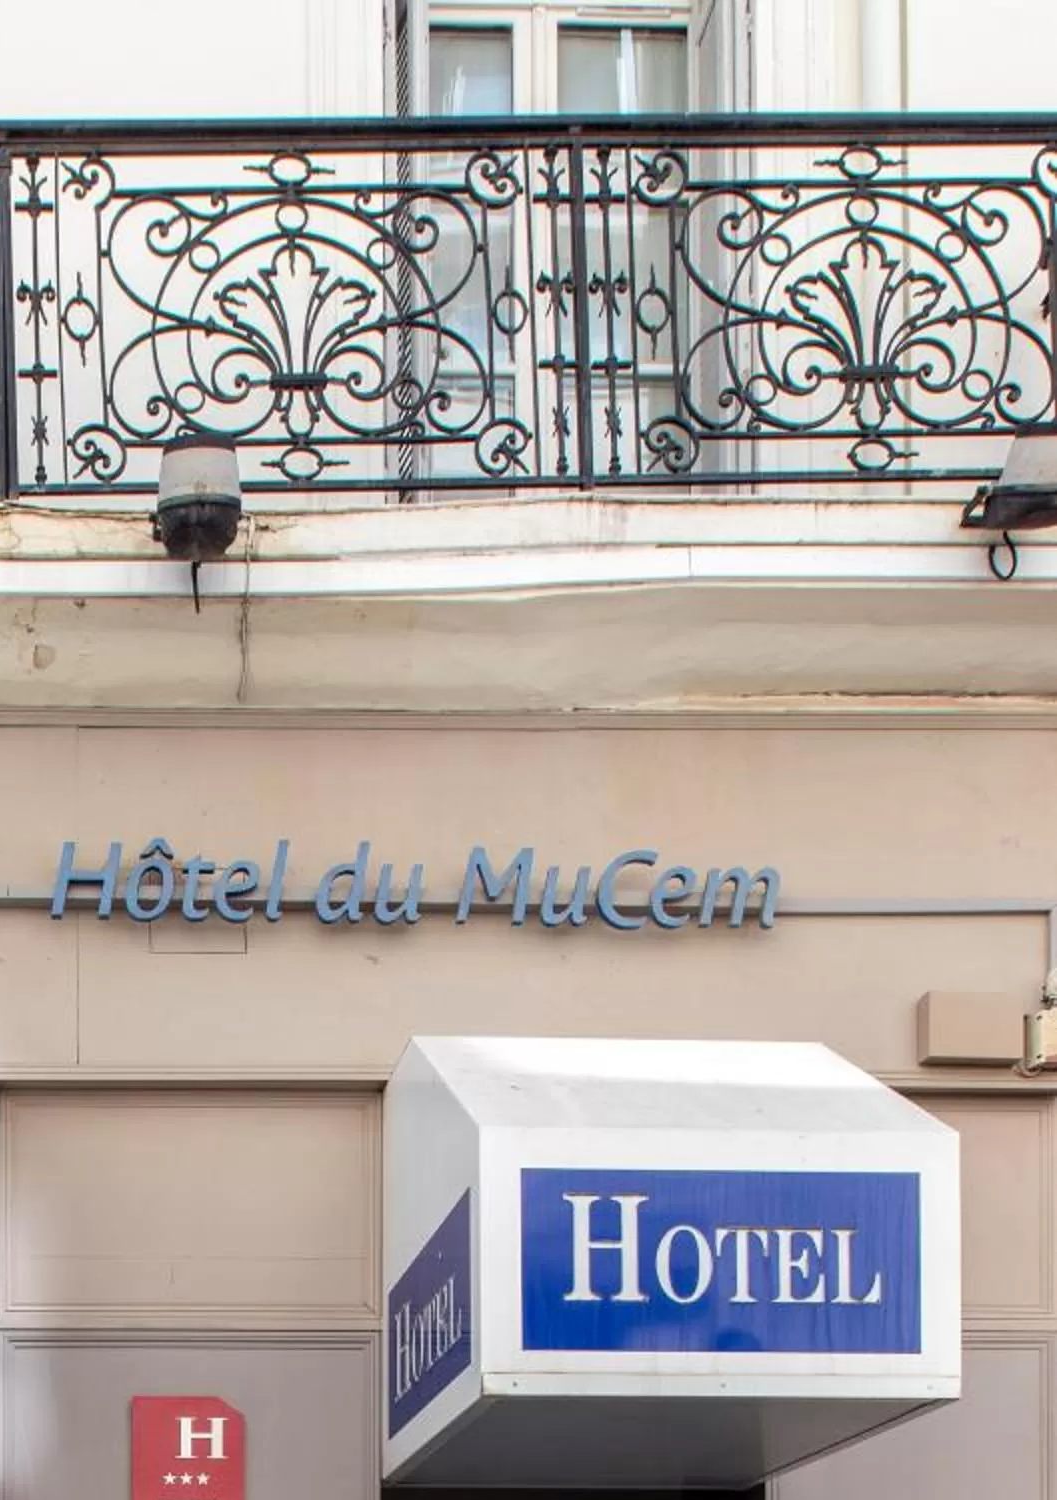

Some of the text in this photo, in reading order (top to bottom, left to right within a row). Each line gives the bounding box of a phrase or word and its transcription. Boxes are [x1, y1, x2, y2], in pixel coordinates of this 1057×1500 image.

[49, 836, 291, 924] Hôtel
[313, 840, 425, 926] du
[455, 845, 781, 931] MuCem
[563, 1193, 883, 1306] HOTEL
[393, 1274, 463, 1404] HOTEL
[174, 1416, 229, 1460] H
